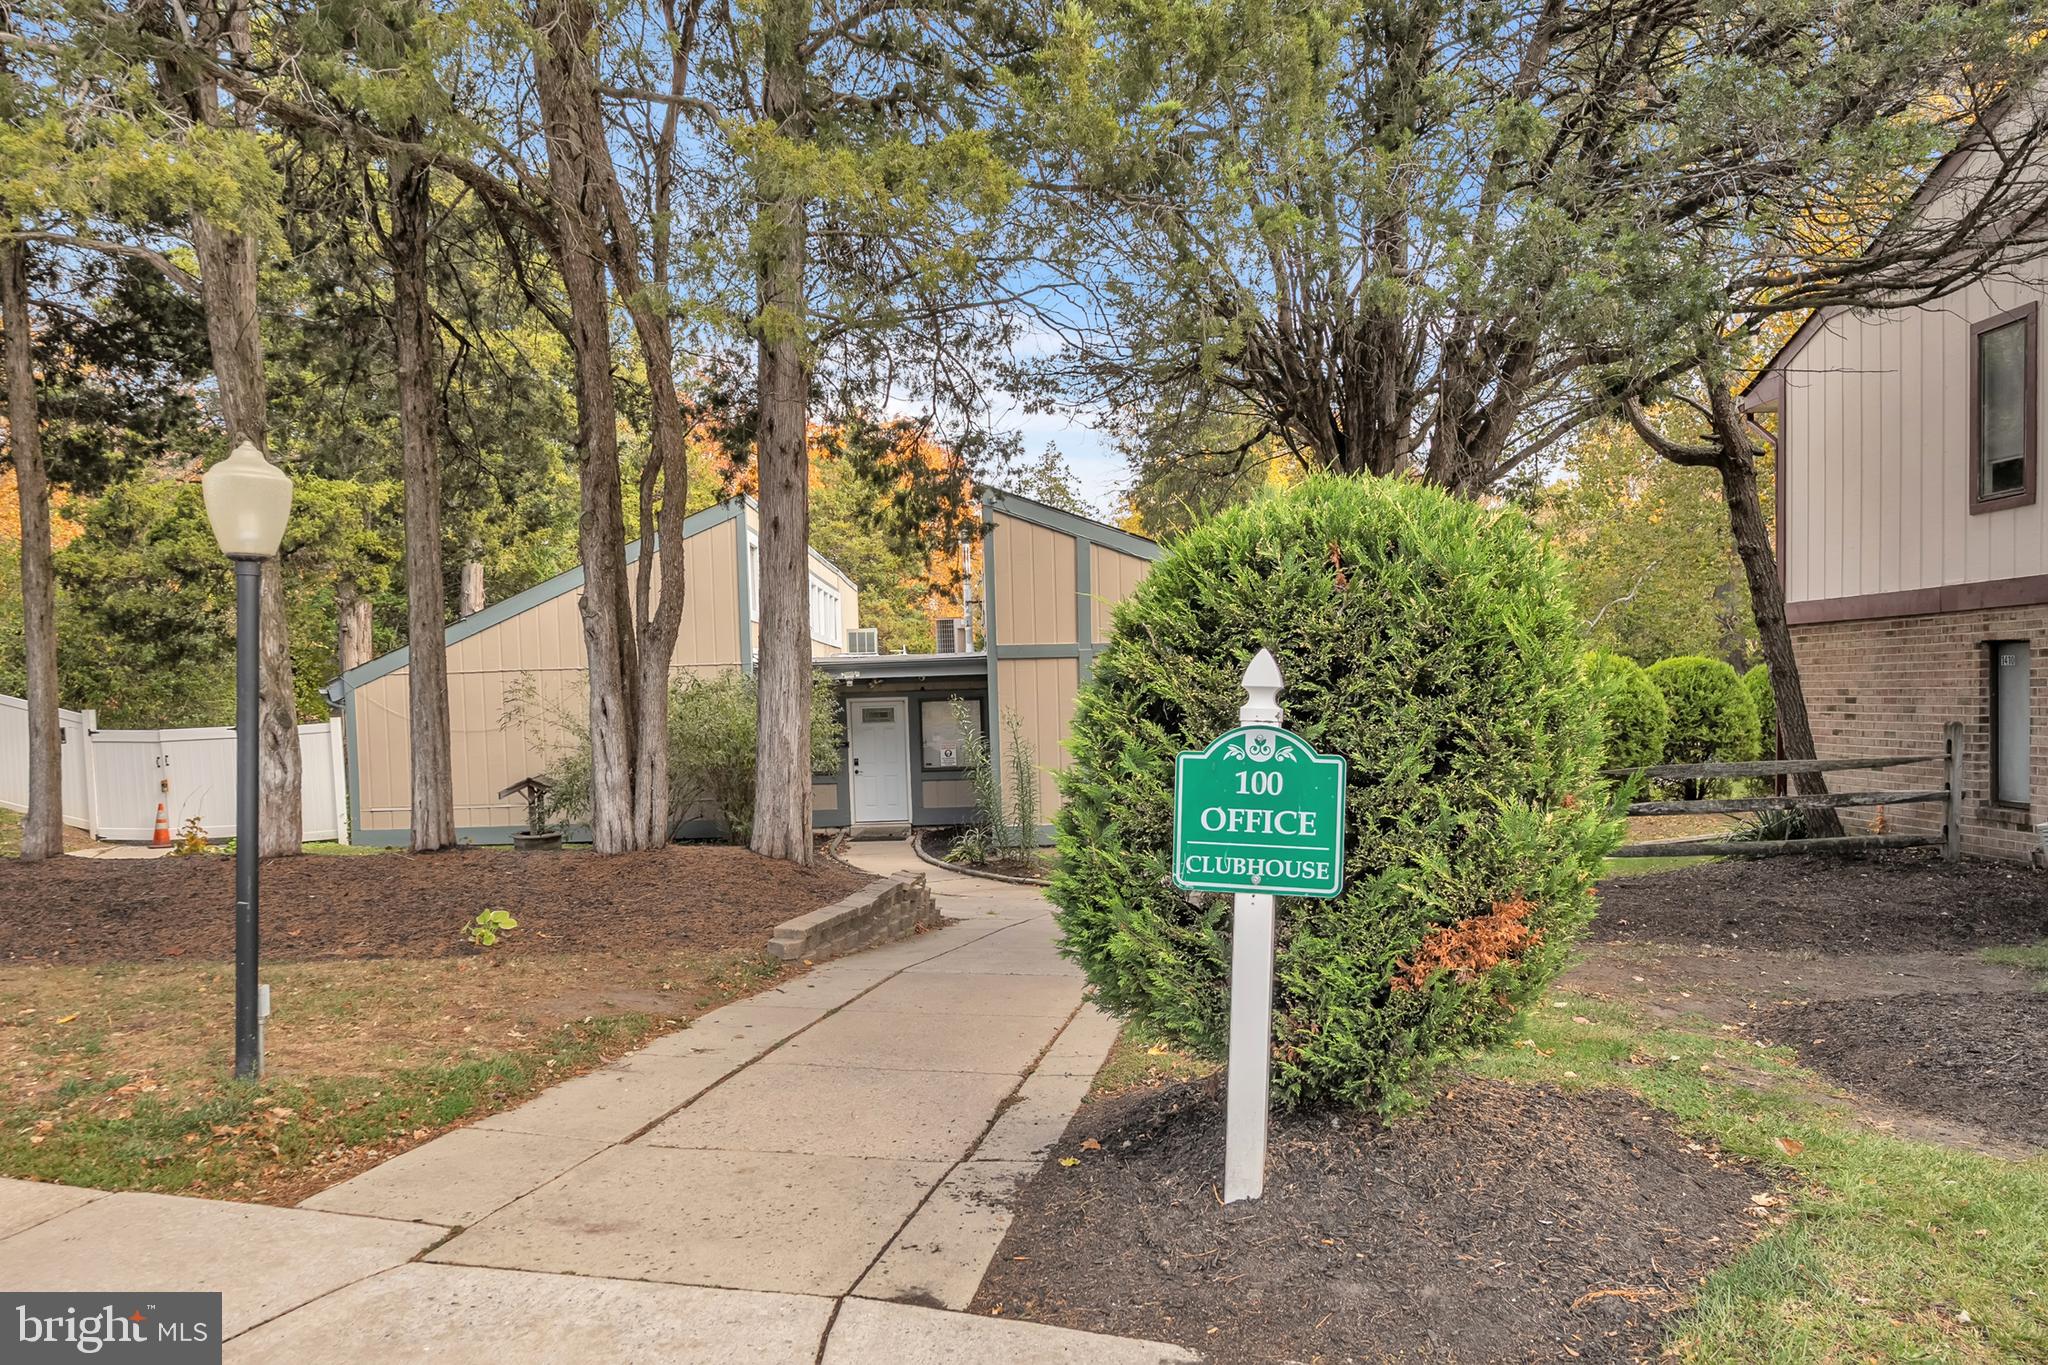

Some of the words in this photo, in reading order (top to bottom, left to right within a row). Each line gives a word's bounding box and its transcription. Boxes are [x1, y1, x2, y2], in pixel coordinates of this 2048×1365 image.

[1235, 771, 1284, 796] 100
[1201, 806, 1317, 836] OFFICE
[1185, 855, 1330, 880] CLUBHOUSE
